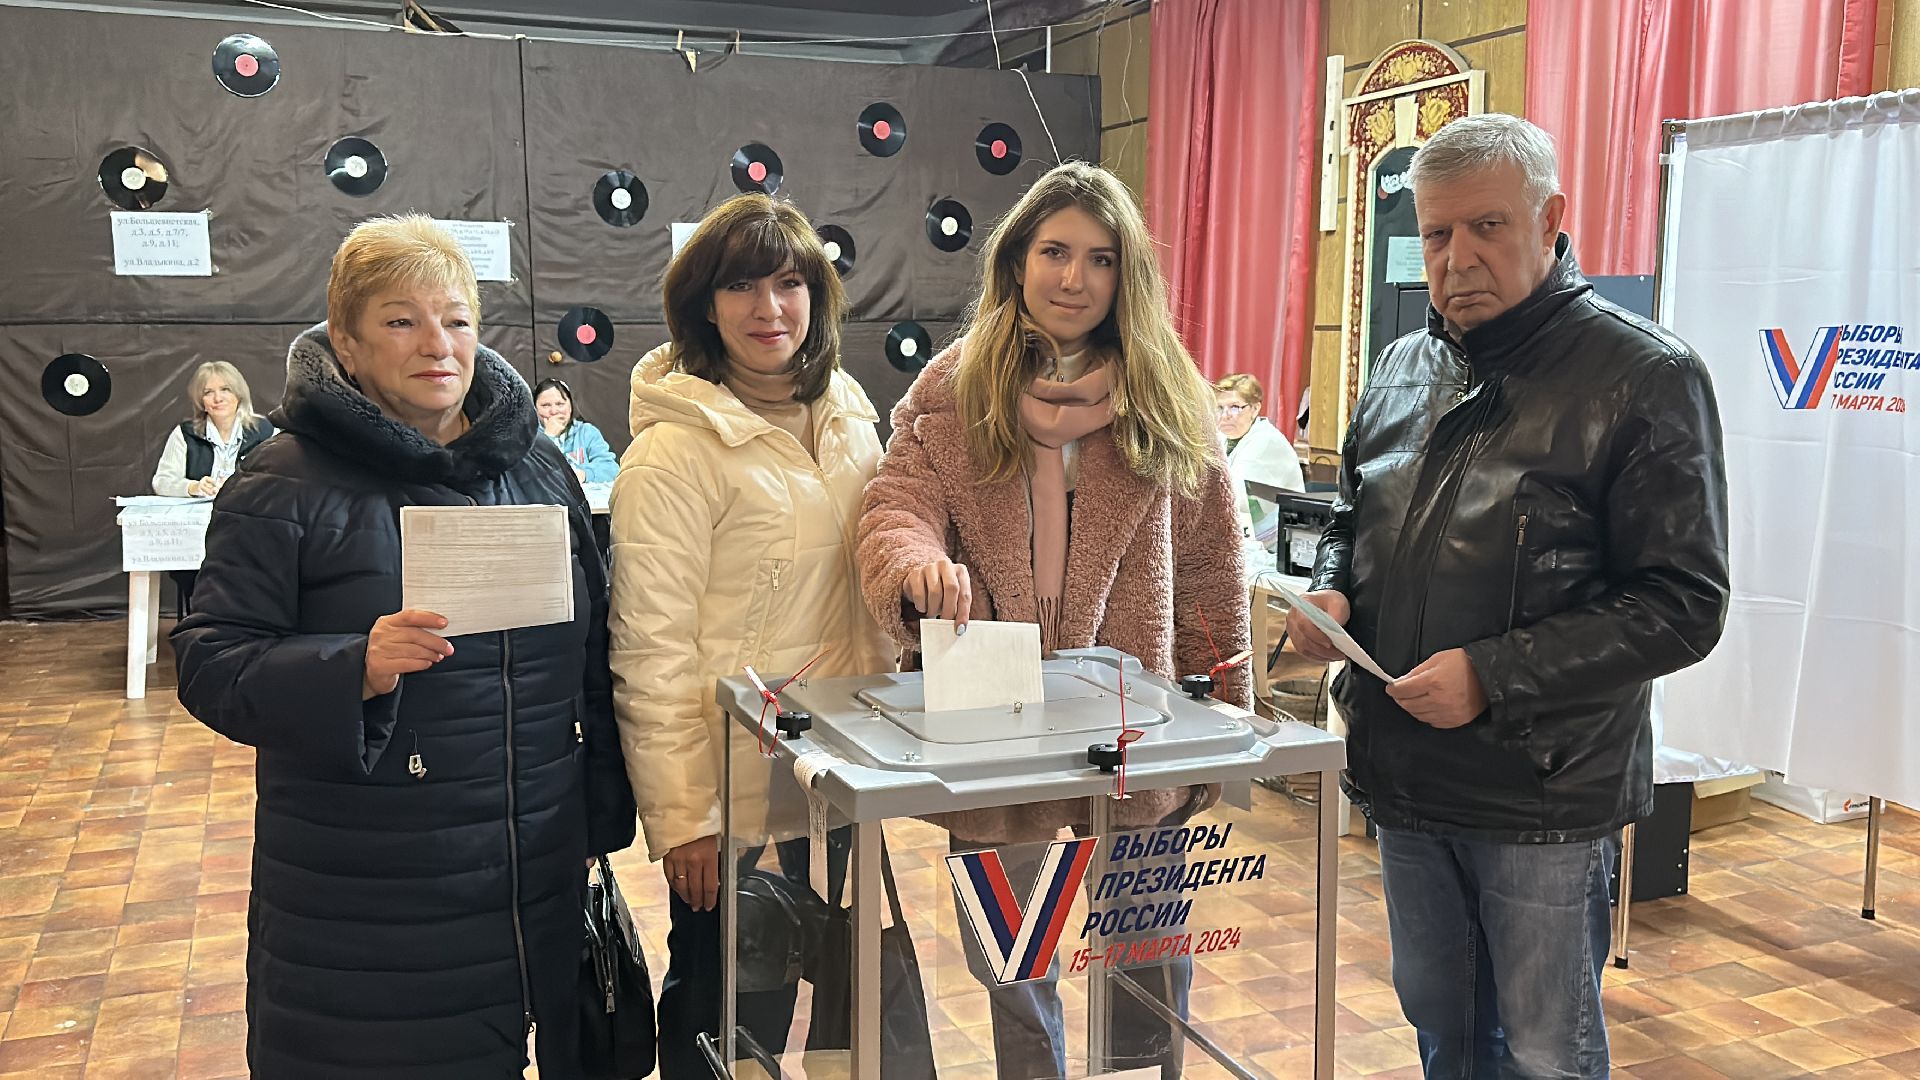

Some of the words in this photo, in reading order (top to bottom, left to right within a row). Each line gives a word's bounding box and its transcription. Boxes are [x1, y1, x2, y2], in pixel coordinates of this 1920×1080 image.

[1834, 371, 1886, 390] ССИИ
[1836, 394, 1884, 411] МАРТА
[1110, 823, 1233, 862] ВЫБОРЫ
[1094, 854, 1266, 900] ПРЕЗИДЕНТА
[1080, 899, 1193, 939] РОССИИ
[1124, 933, 1193, 966] МАРТА
[1194, 927, 1241, 955] 2024
